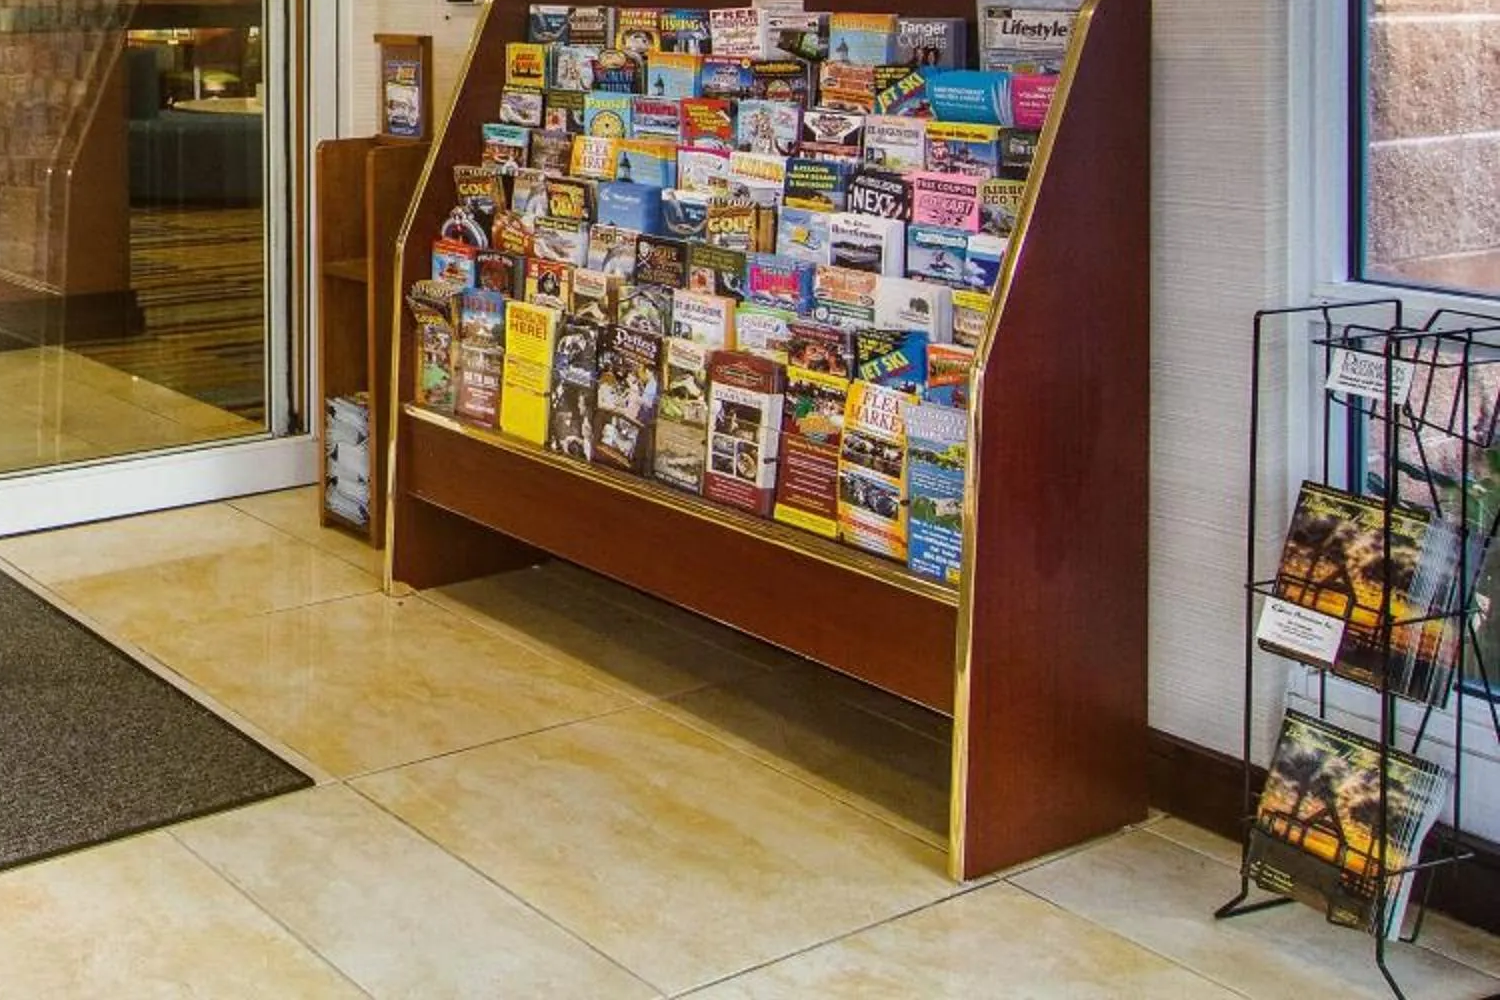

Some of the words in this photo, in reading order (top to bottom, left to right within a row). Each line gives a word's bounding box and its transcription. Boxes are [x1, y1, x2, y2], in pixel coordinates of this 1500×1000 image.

[899, 20, 948, 38] Tanger
[1002, 19, 1068, 39] Lifestyle
[899, 33, 948, 50] Outlets
[708, 216, 755, 233] GOLF
